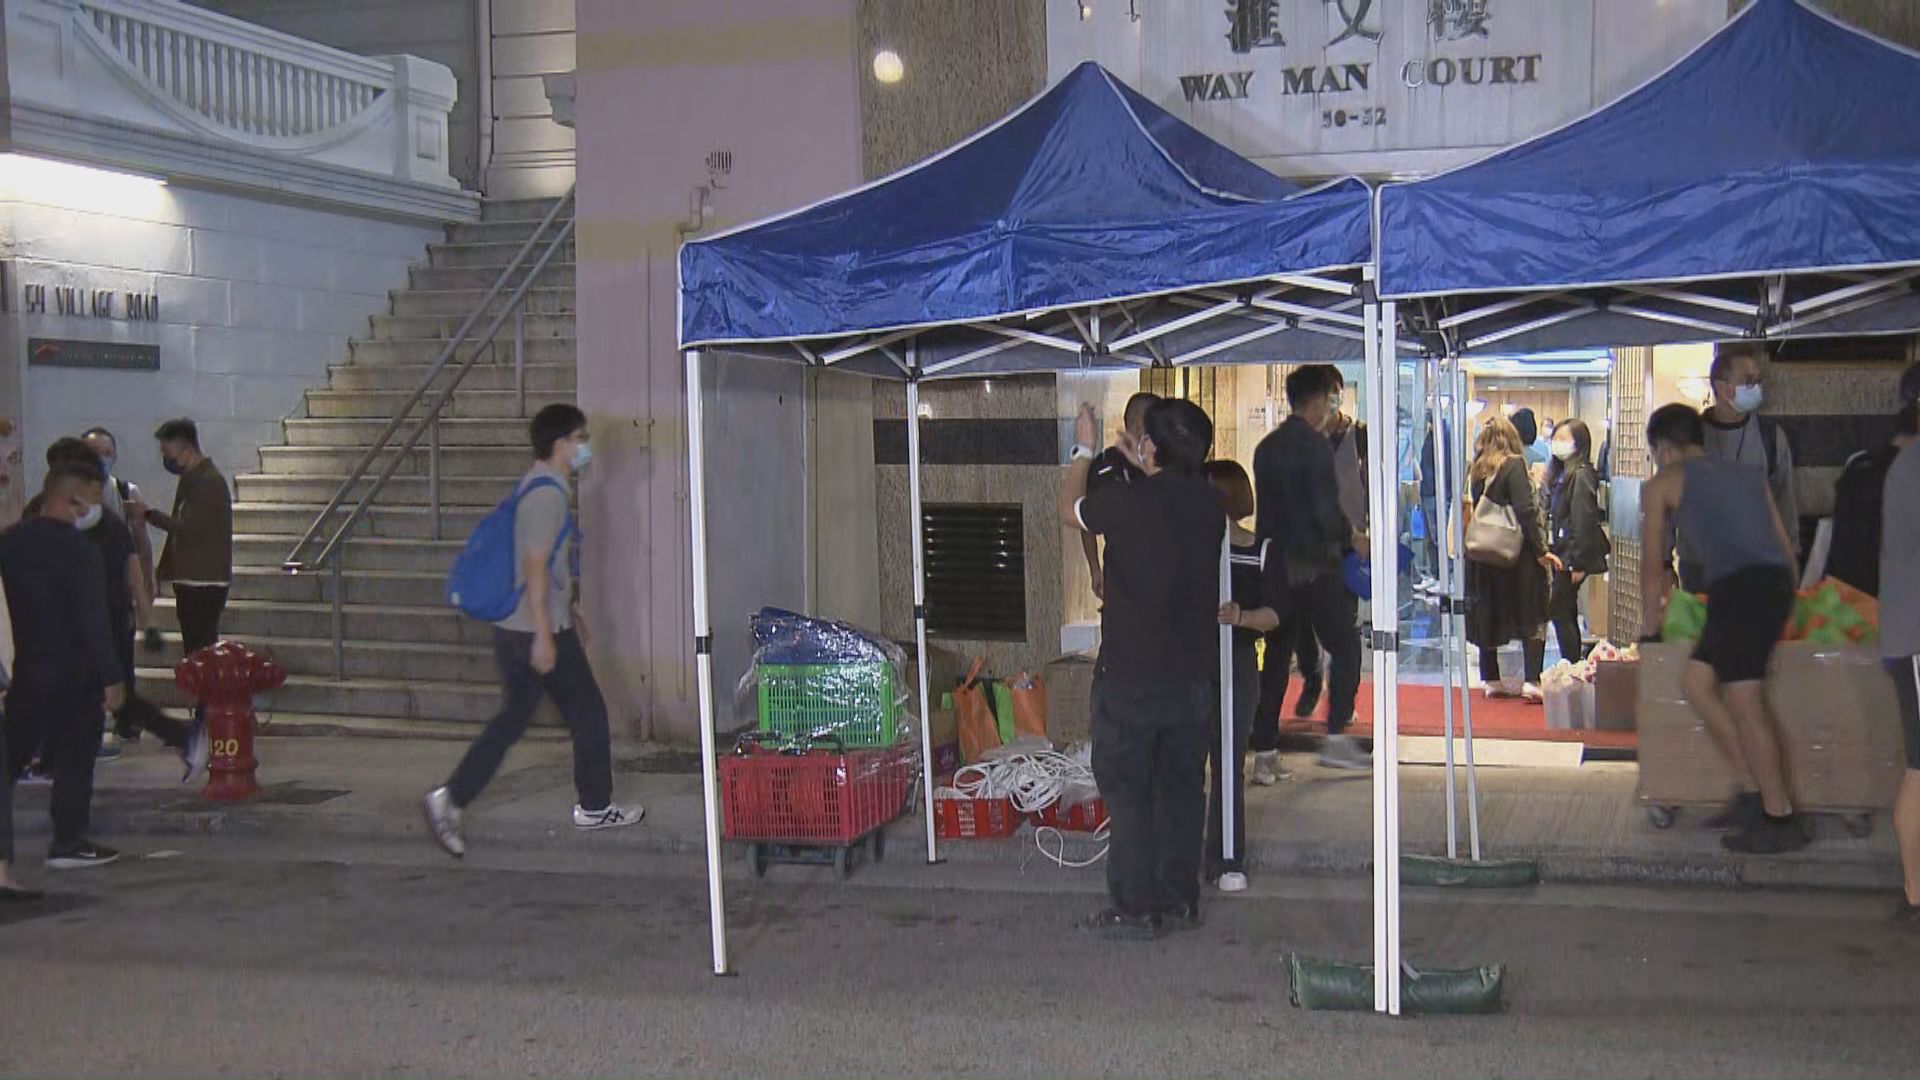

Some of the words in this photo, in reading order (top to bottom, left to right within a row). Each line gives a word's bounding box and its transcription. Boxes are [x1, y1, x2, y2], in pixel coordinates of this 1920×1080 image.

[1179, 71, 1254, 101] WAY
[1281, 63, 1370, 95] MAN
[1400, 54, 1542, 88] COURT
